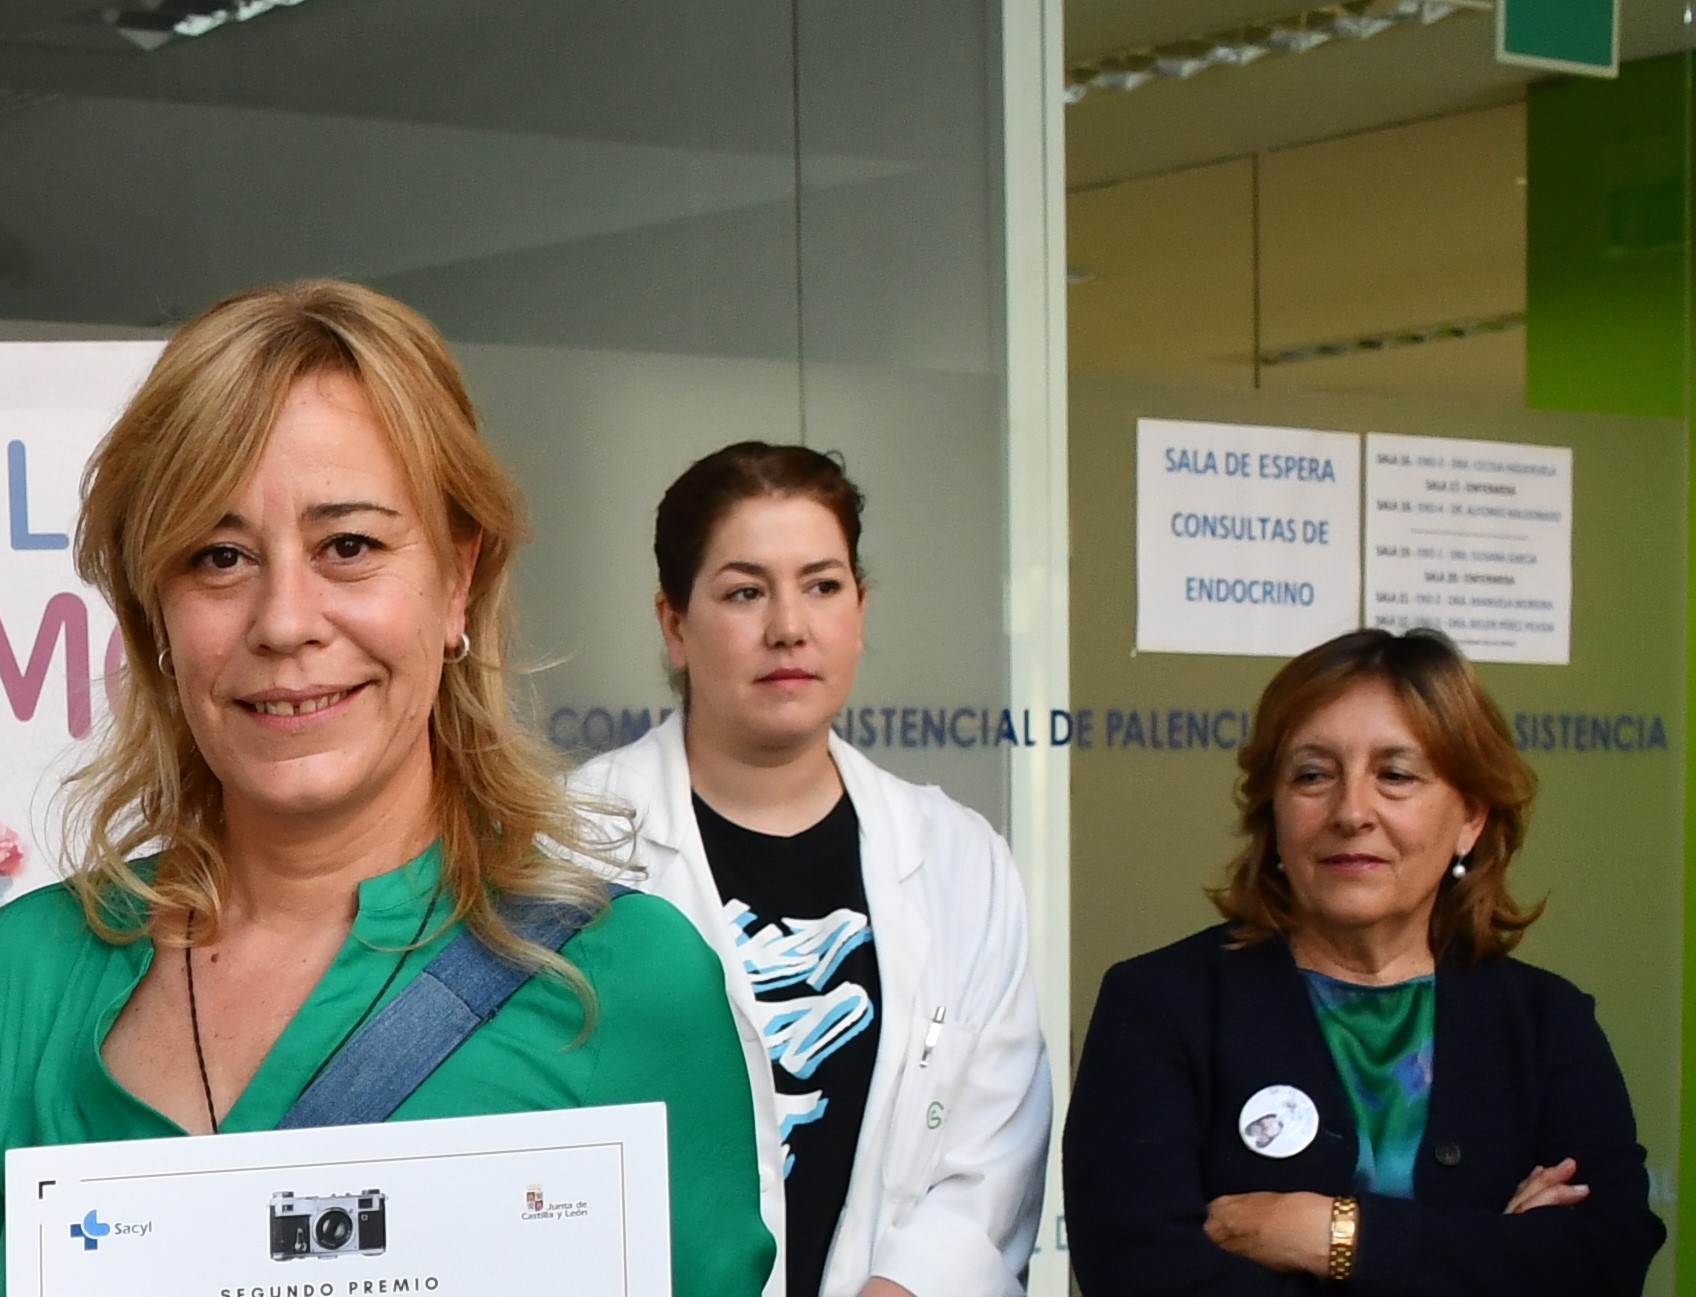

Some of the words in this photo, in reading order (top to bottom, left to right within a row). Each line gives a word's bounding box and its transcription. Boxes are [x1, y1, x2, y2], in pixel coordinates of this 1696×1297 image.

[1165, 447, 1217, 476] SALA
[1226, 451, 1251, 478] DE
[1260, 454, 1336, 484] ESPERA
[1171, 512, 1297, 544] CONSULTAS
[1303, 519, 1329, 544] DE
[1185, 577, 1315, 607] ENDOCRINO
[1050, 709, 1093, 749] DE
[1107, 708, 1249, 749] PALENCI
[1515, 712, 1667, 752] SISTENCIA
[521, 1211, 554, 1220] Castilla
[557, 1212, 562, 1220] y
[565, 1209, 588, 1218] León
[547, 1203, 572, 1211] Junta
[576, 1201, 588, 1209] de
[114, 1218, 152, 1237] Sacyl
[348, 1276, 440, 1296] PREMIO
